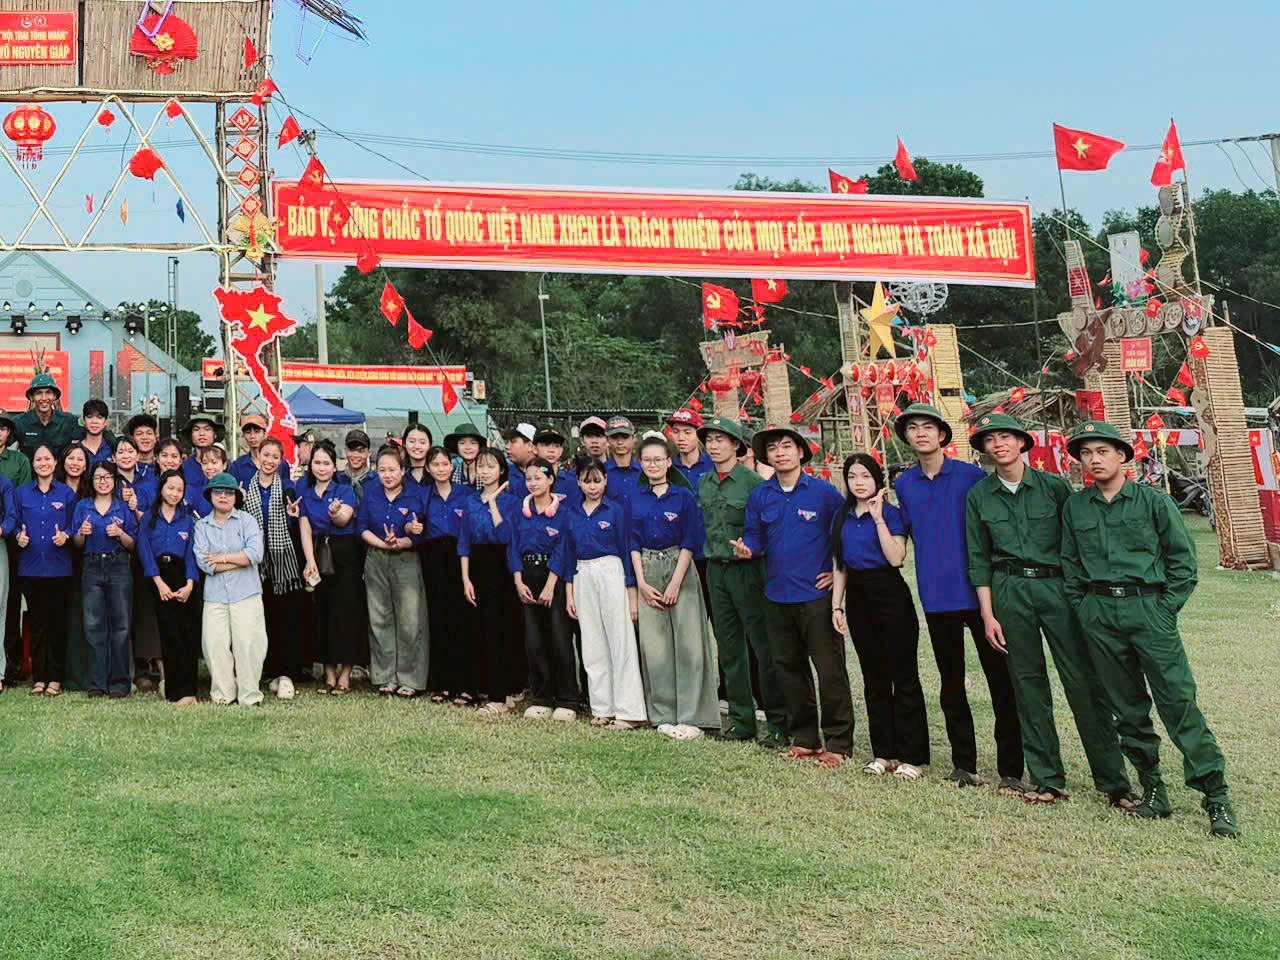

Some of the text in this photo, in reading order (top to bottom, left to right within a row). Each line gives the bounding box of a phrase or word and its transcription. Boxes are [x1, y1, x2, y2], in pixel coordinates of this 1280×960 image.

[0, 43, 70, 59] VÕ NGUYÊN GIÁP
[287, 195, 317, 236] BẢO
[382, 198, 420, 241] CHẮC
[424, 198, 441, 241] TỔ
[445, 199, 483, 244] QUỐC
[487, 206, 517, 250] VIỆT
[521, 210, 555, 245] NAM
[558, 214, 599, 247] XHCN
[602, 210, 620, 247] LÀ
[622, 213, 671, 248] TRÁCH
[673, 212, 721, 256] NHIỆM
[723, 210, 752, 250] CỦA
[755, 221, 784, 259] MỌI
[787, 212, 819, 256] CẤP,
[821, 223, 850, 260] MỌI
[853, 218, 903, 255] NGÀNH
[904, 219, 922, 256] VÀ
[925, 220, 963, 257] TOÀN
[967, 221, 987, 258] XÃ
[989, 222, 1019, 265] HỘI!
